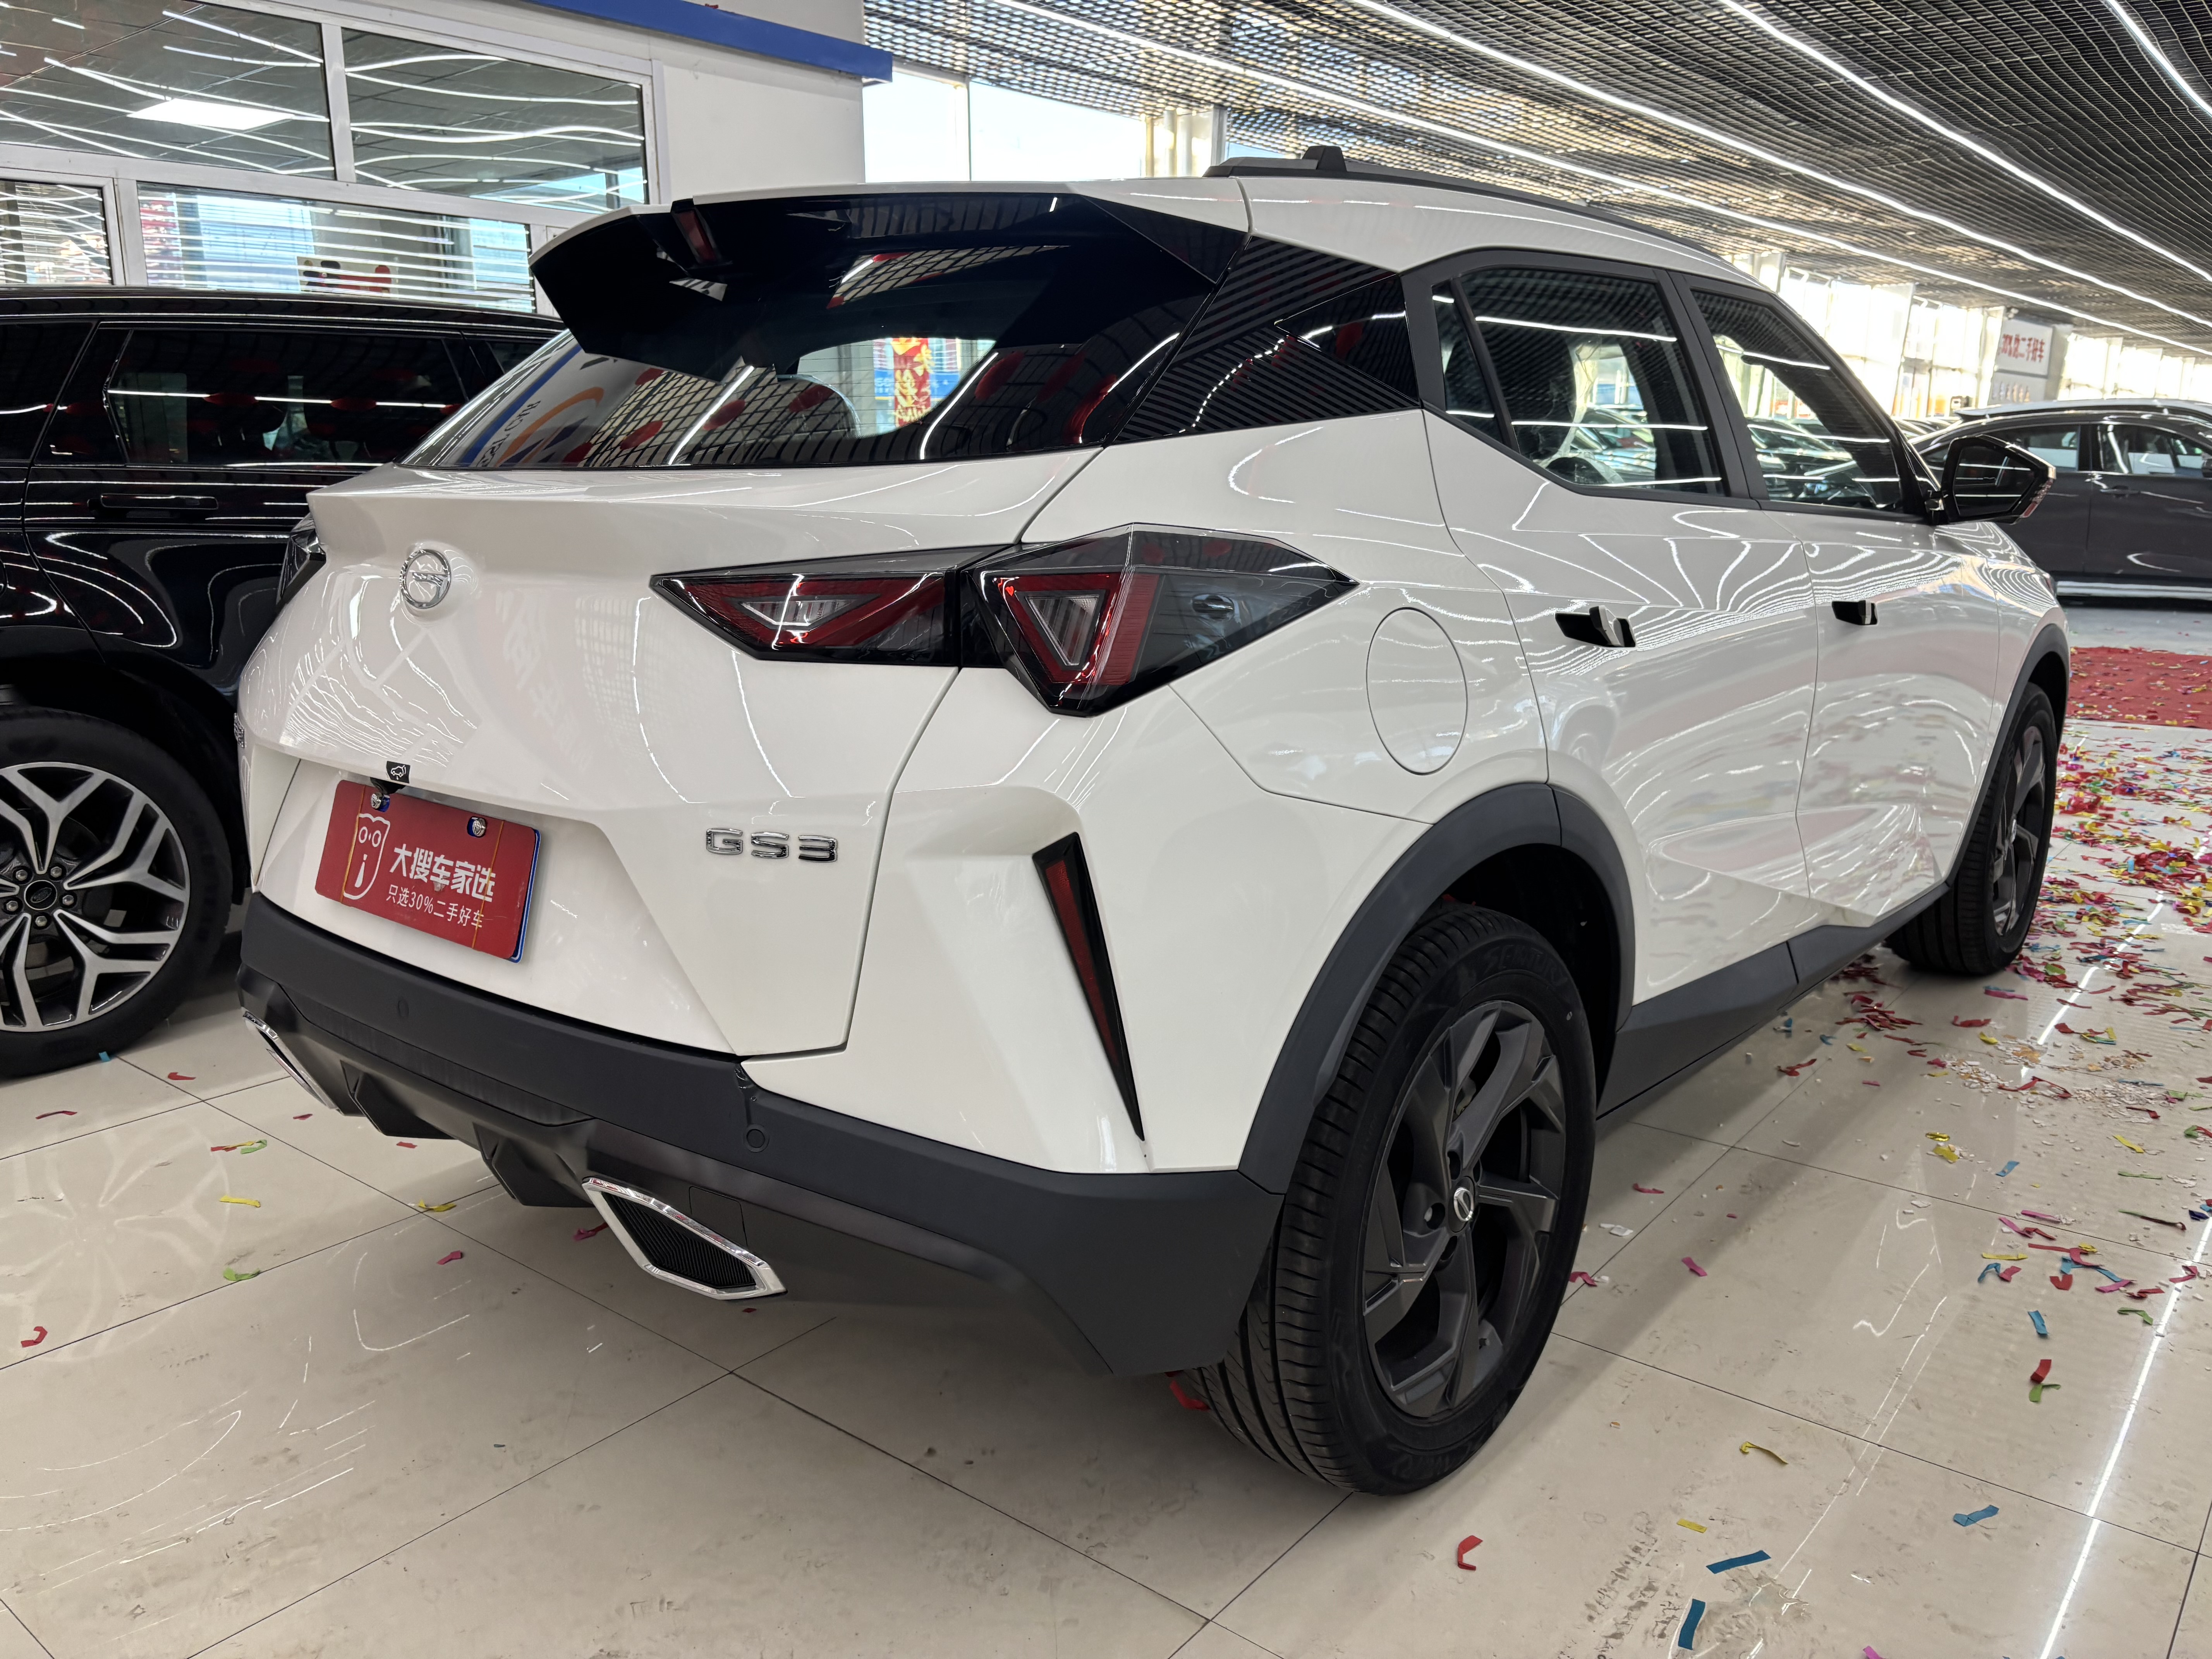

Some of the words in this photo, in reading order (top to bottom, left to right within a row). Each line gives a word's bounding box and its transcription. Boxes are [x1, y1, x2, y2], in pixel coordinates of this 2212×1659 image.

[706, 827, 838, 863] GS3
[389, 843, 496, 902] 大搜车家选
[386, 884, 484, 927] 只选30%二手好车
